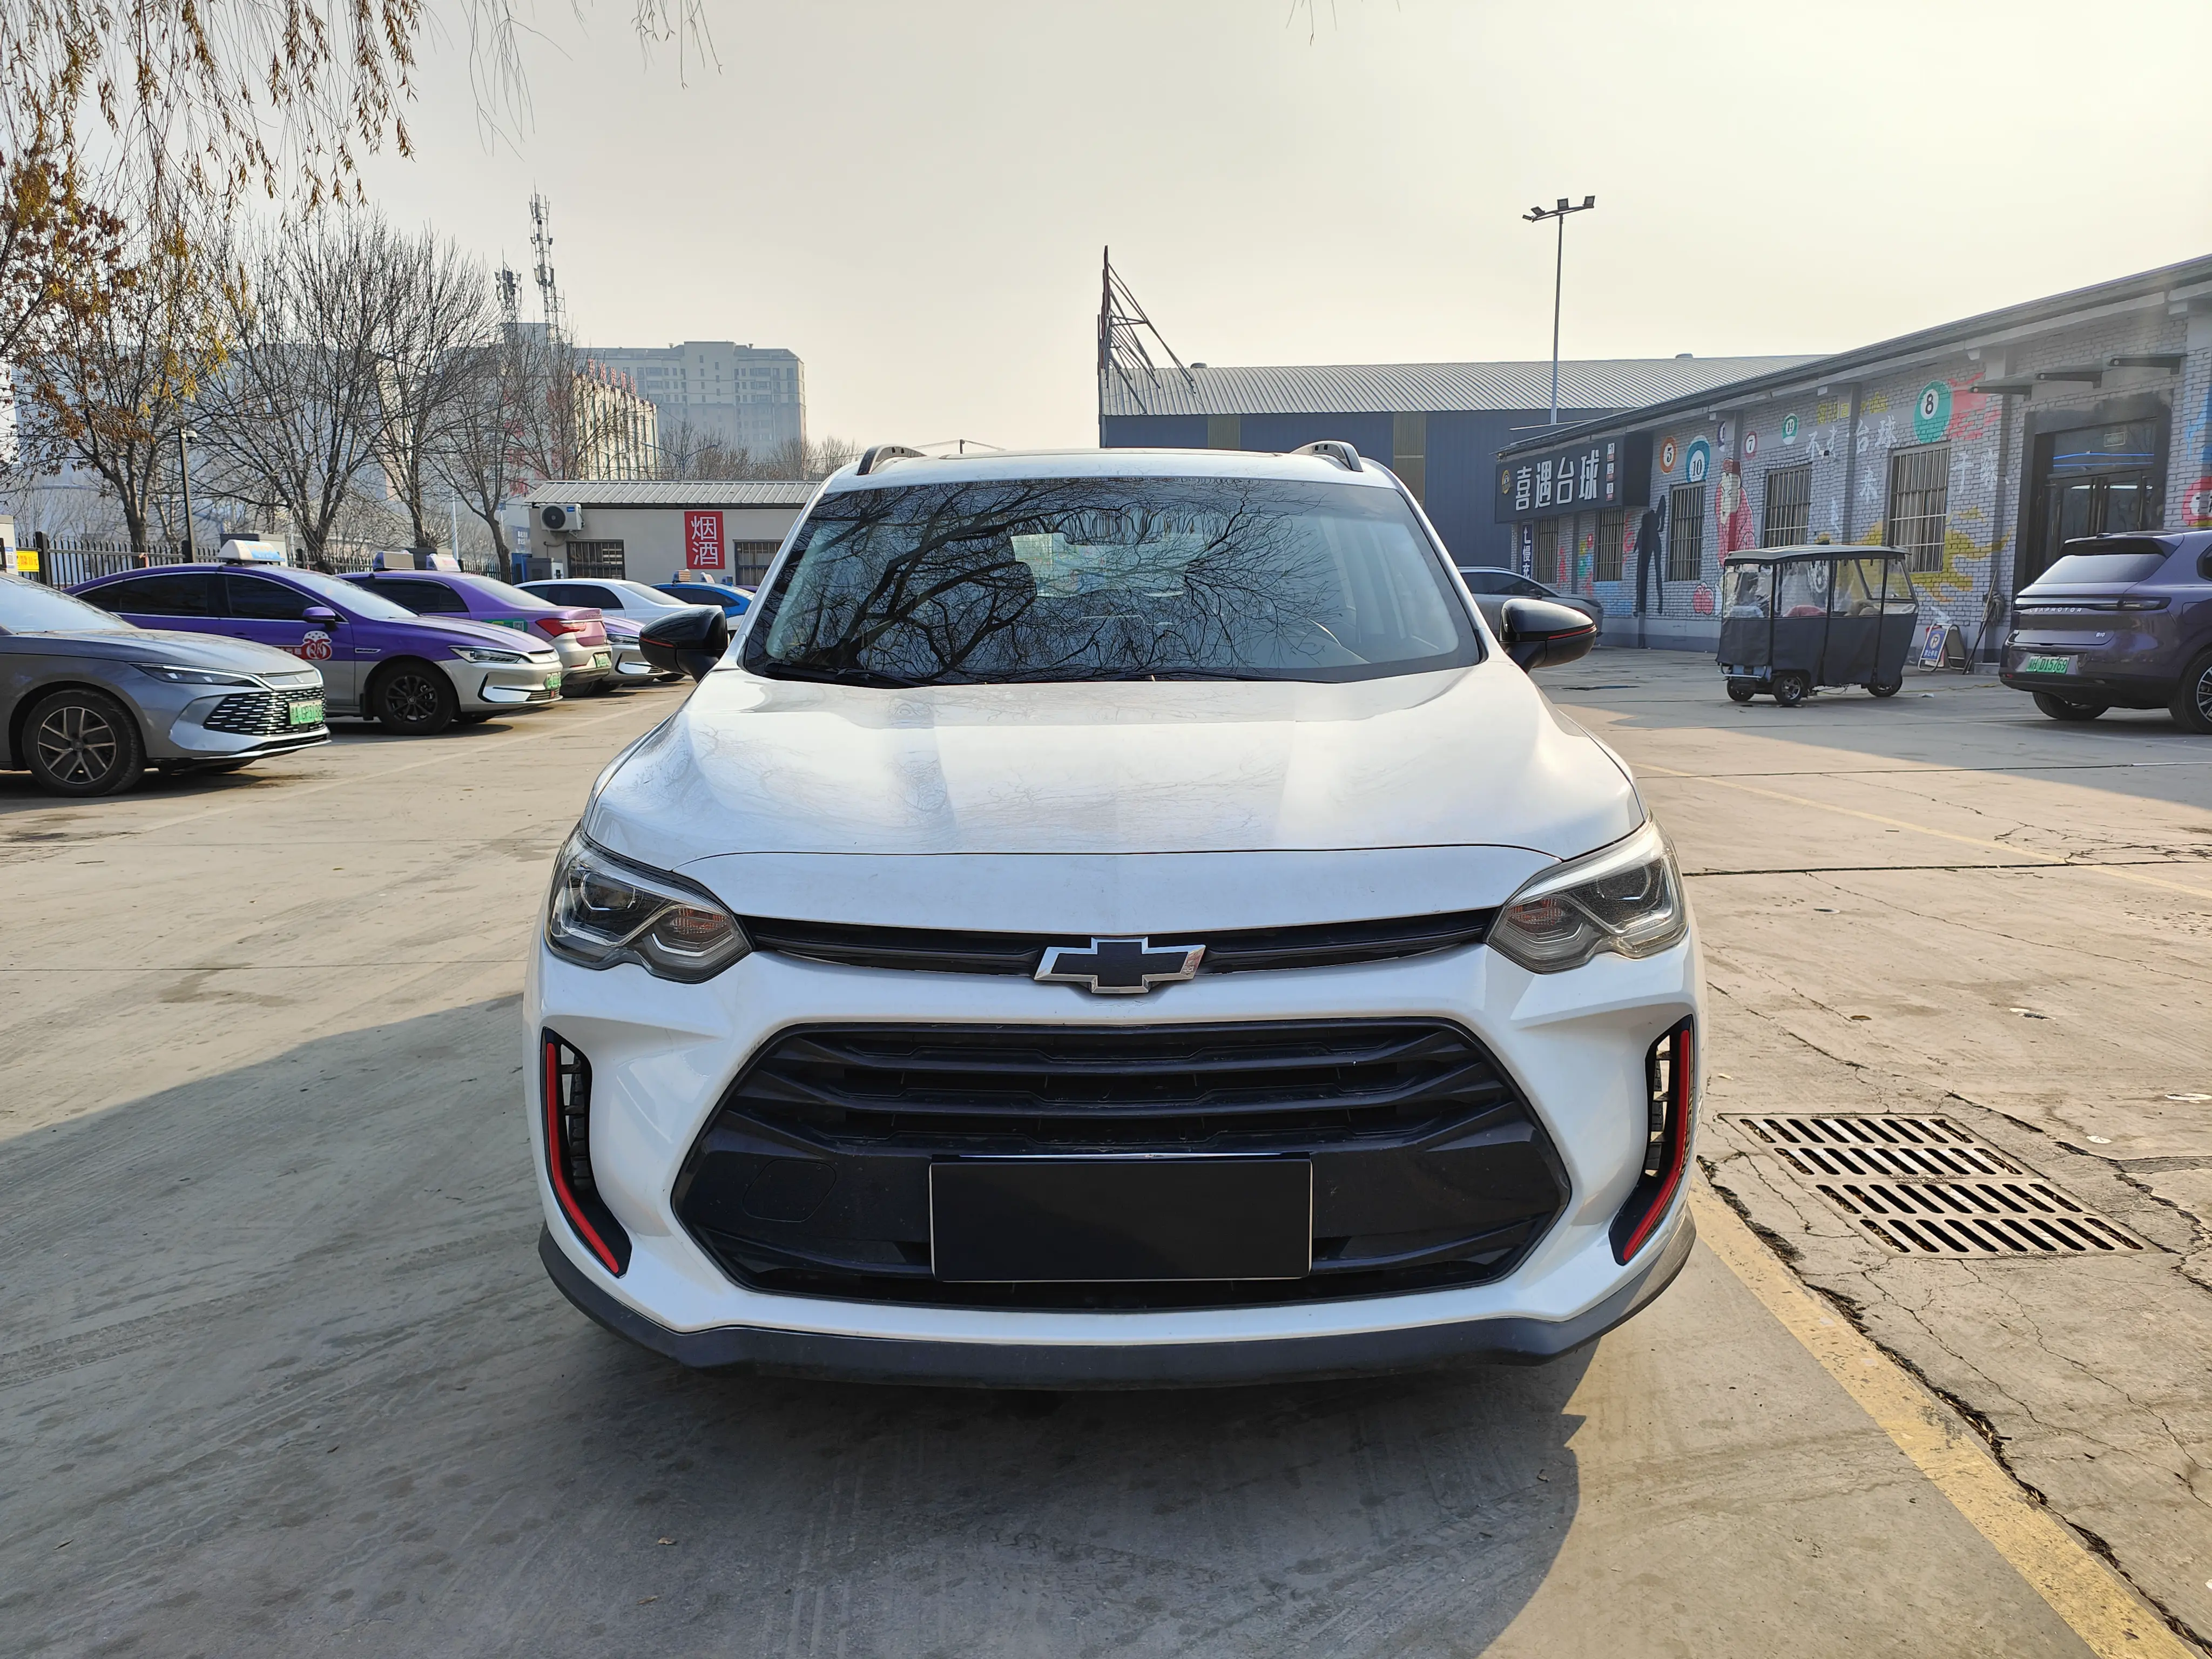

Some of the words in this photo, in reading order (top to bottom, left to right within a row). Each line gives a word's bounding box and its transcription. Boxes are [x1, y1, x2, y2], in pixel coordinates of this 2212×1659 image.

[1925, 393, 1934, 414] 8
[1667, 447, 1672, 463] 5
[1748, 439, 1754, 450] 7
[1692, 459, 1702, 477] 10
[1515, 449, 1599, 511] 喜遇台球
[691, 515, 718, 565] 烟酒
[1522, 545, 1531, 579] 慢充
